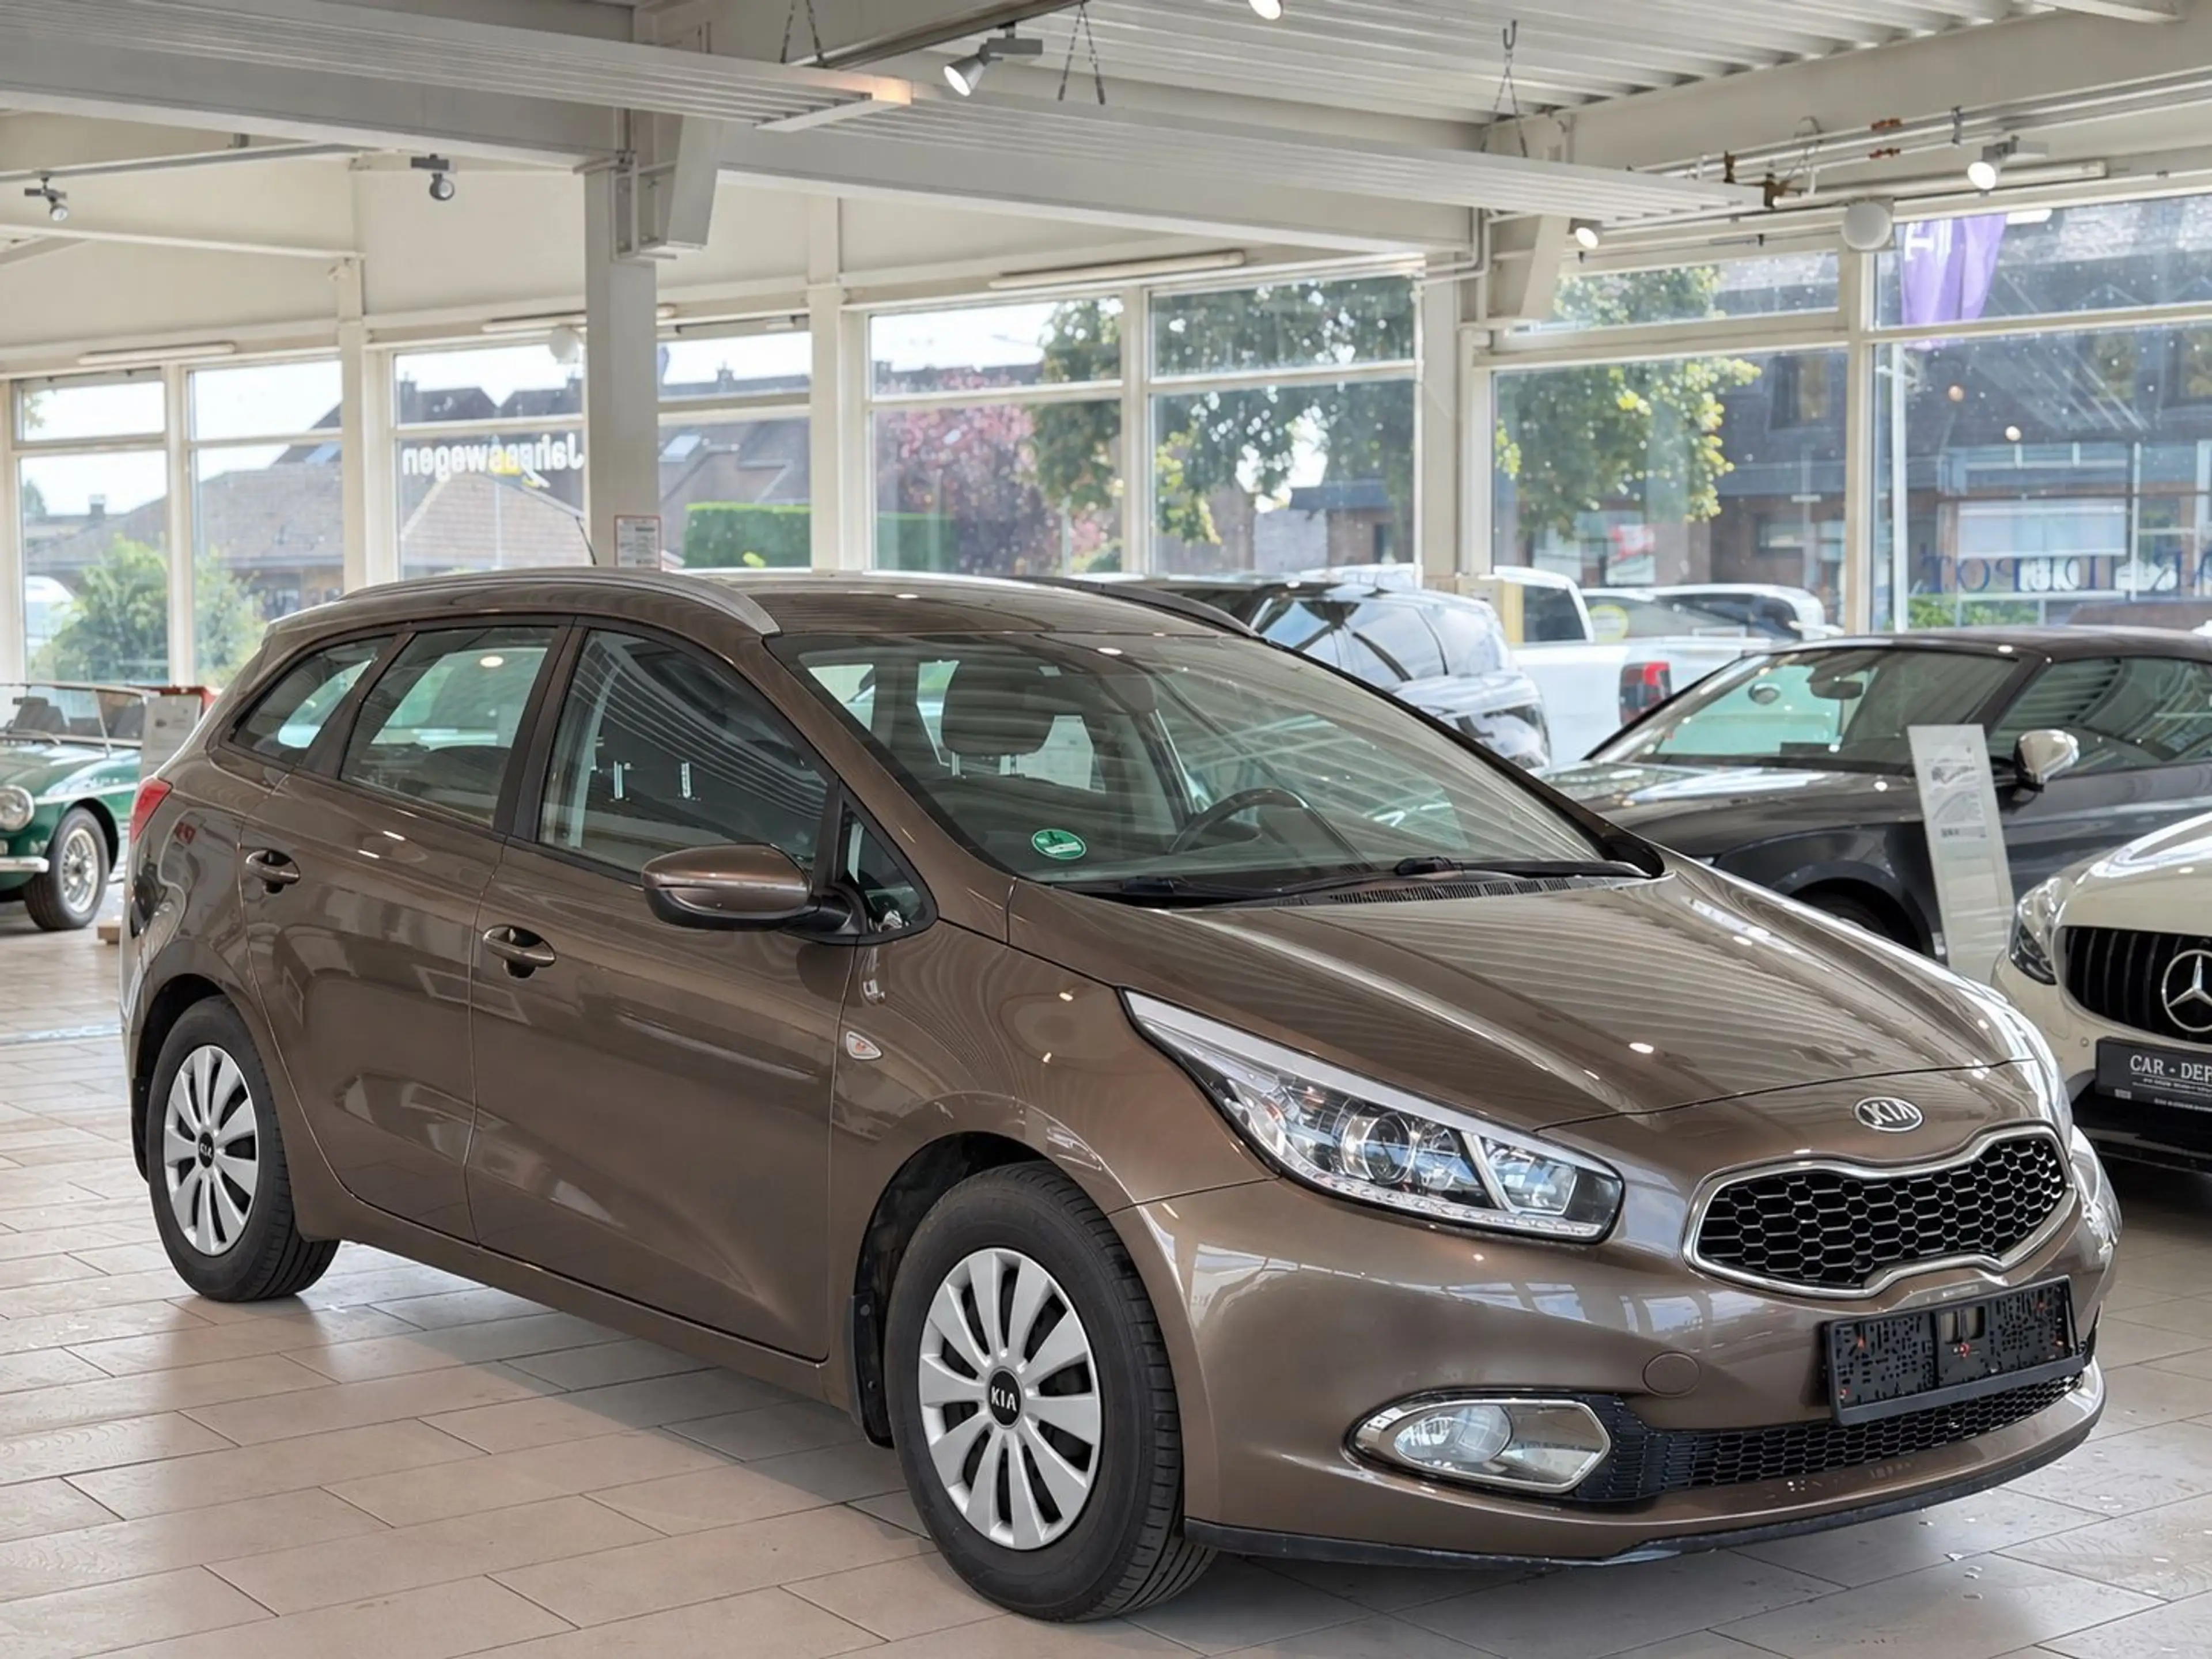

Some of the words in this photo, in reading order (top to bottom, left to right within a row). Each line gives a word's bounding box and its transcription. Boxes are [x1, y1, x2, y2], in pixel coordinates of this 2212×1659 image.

[2130, 1055, 2165, 1075] CAR
[1862, 1100, 1917, 1125] KIA
[991, 1385, 1017, 1411] KIA
